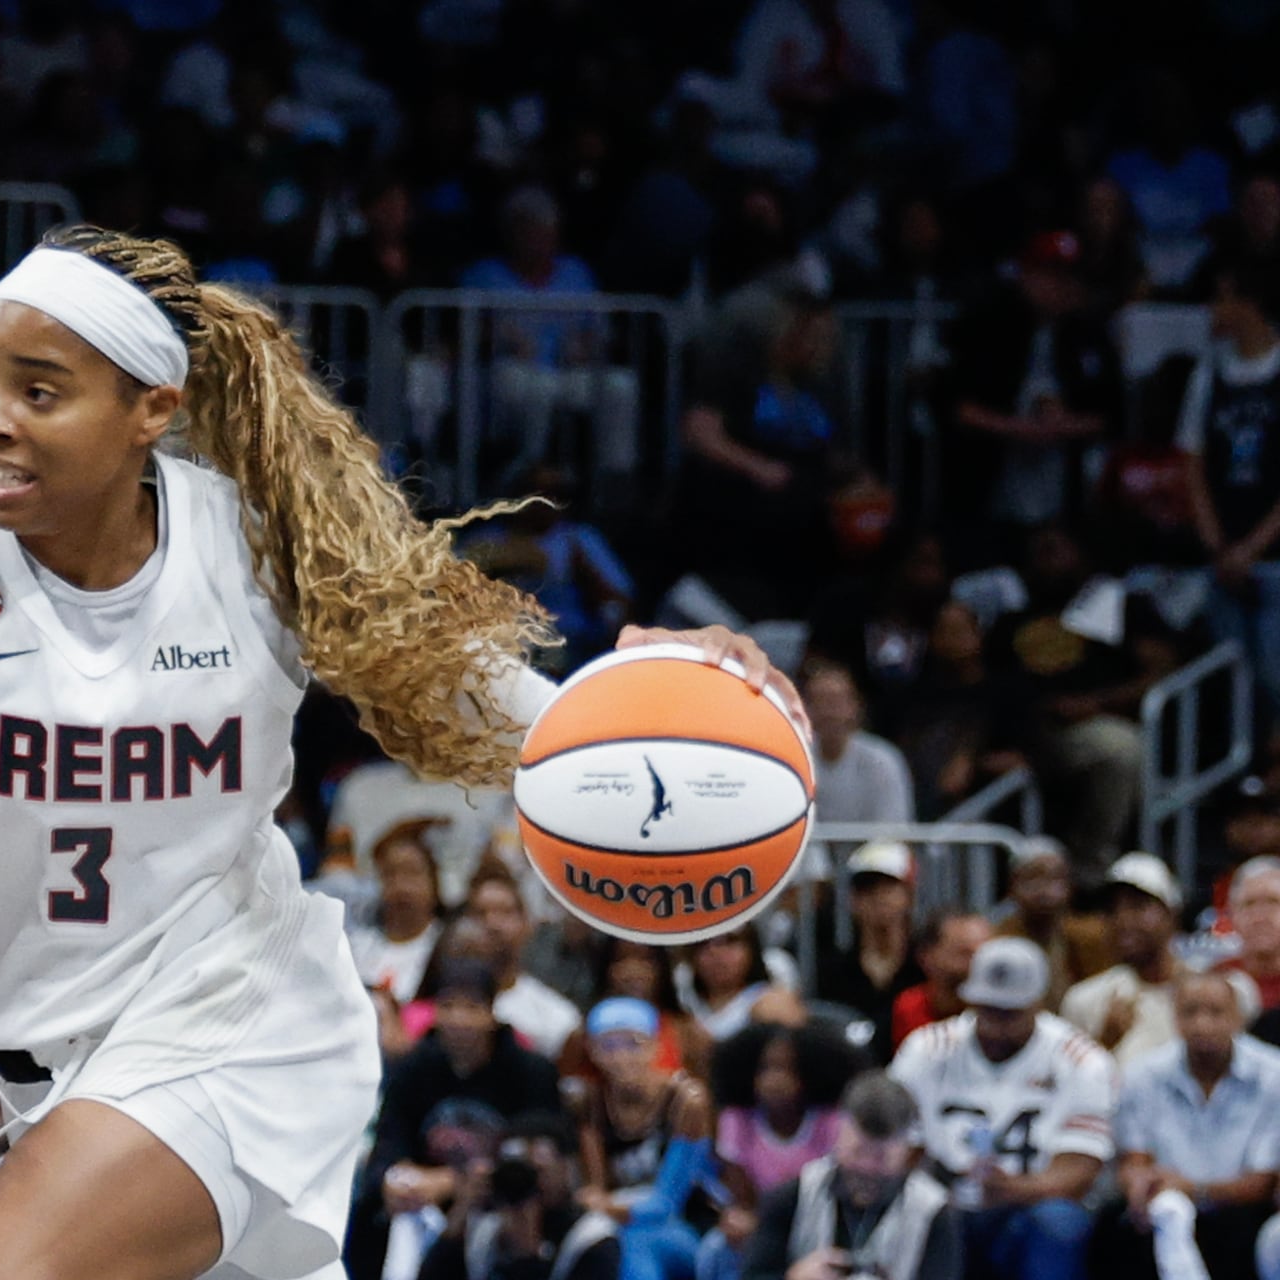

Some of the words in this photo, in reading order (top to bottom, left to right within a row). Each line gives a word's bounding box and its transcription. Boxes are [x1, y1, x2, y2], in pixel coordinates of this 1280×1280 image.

[151, 645, 231, 672] Albert
[48, 827, 112, 924] 3
[564, 862, 755, 918] Wilson
